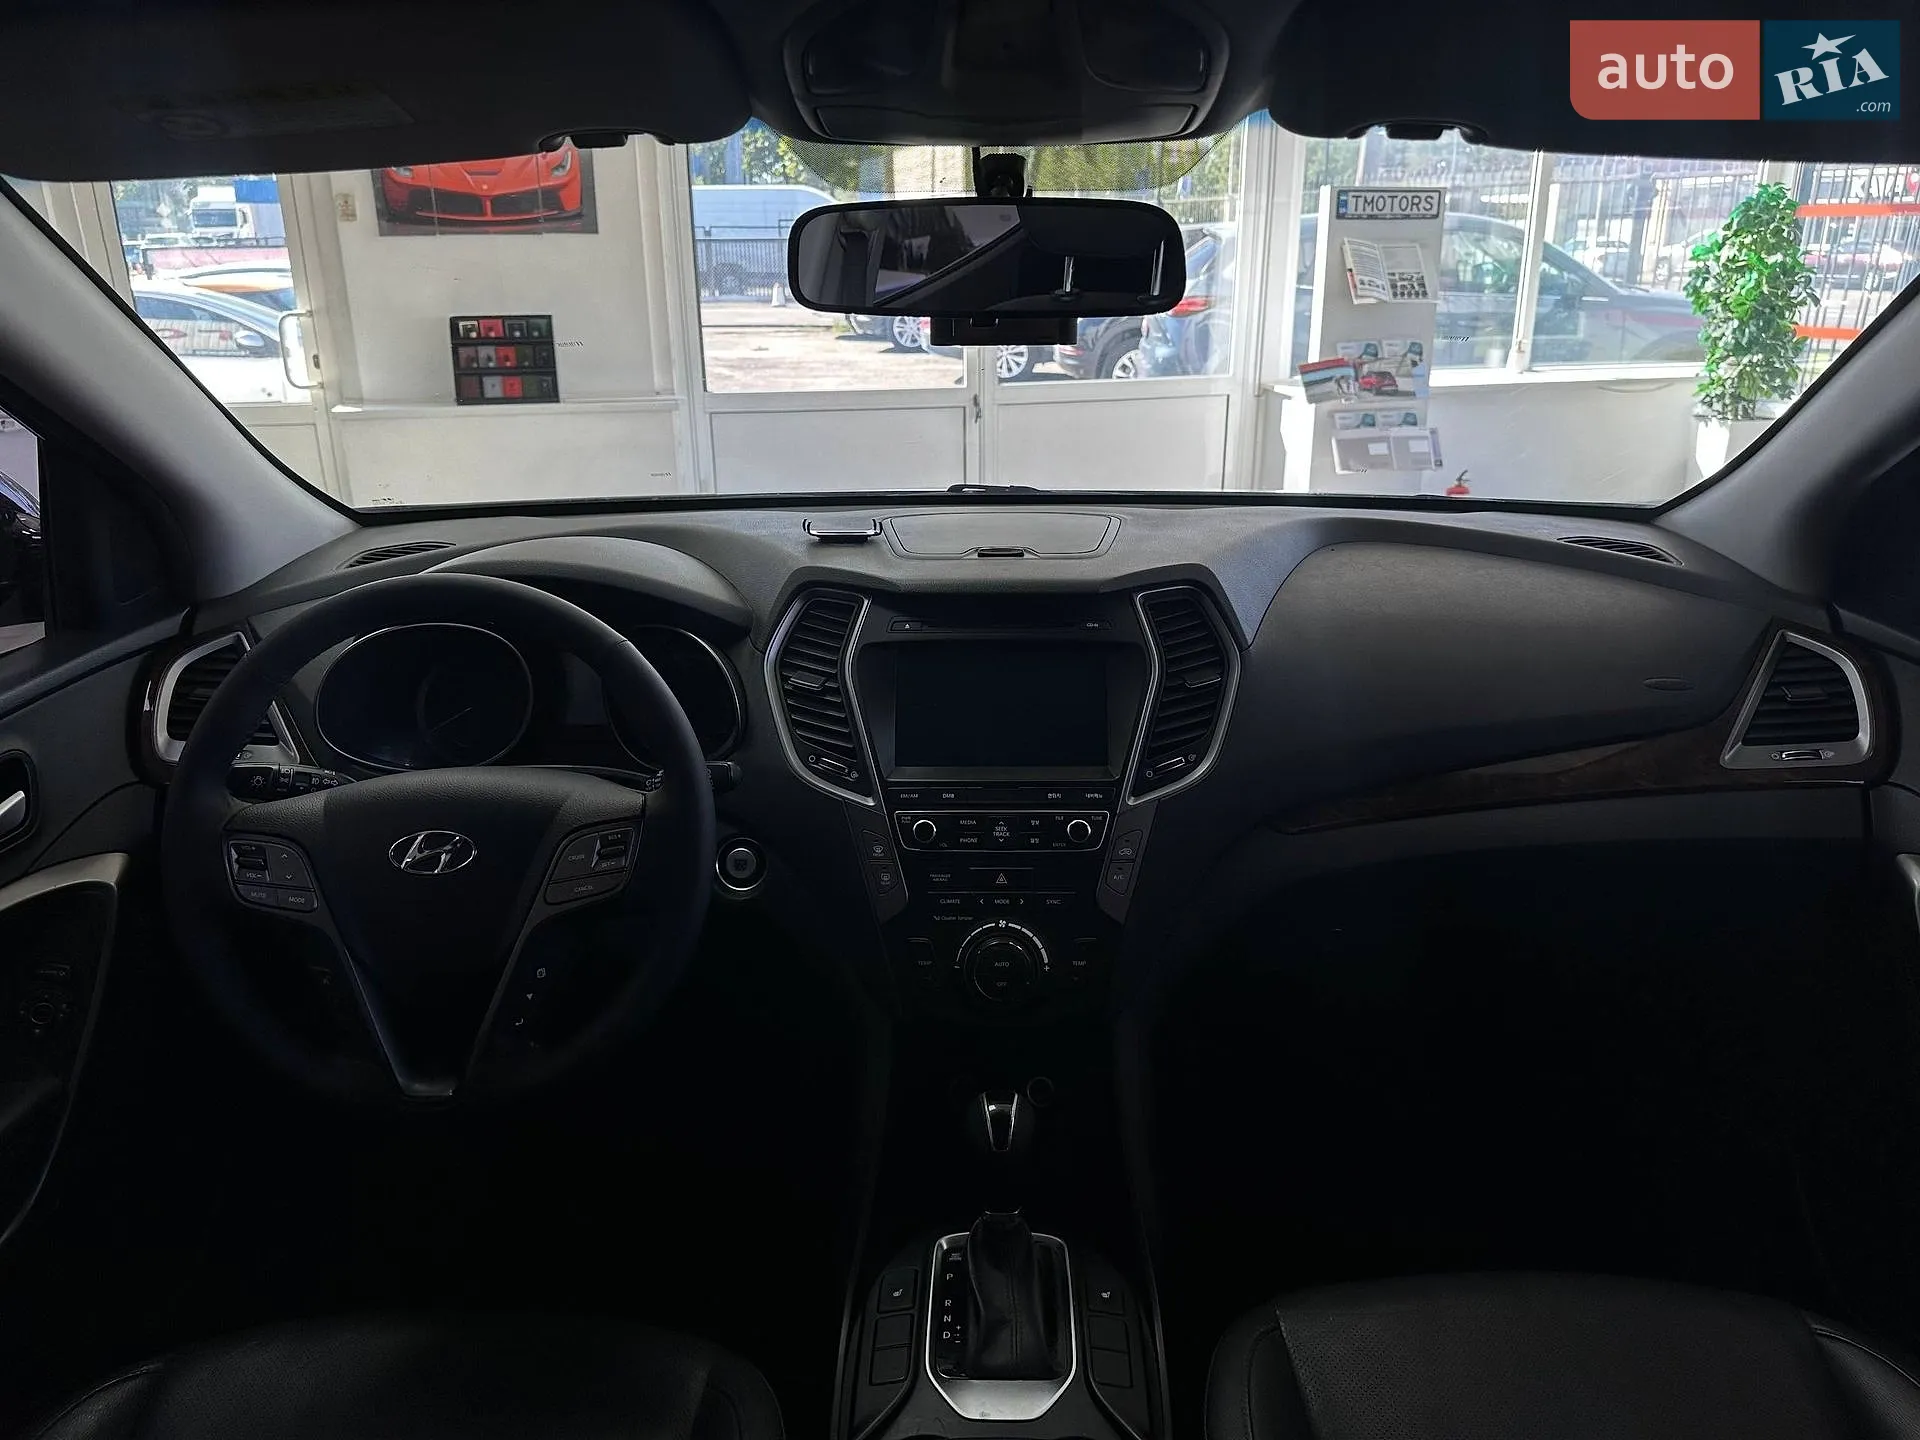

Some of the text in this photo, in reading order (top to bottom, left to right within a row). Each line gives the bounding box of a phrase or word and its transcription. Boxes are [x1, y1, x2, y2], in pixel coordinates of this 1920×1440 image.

[1351, 195, 1434, 213] TMOTORS
[946, 1273, 954, 1281] P
[944, 1299, 952, 1307] R
[943, 1315, 952, 1323] N
[943, 1331, 951, 1339] D
